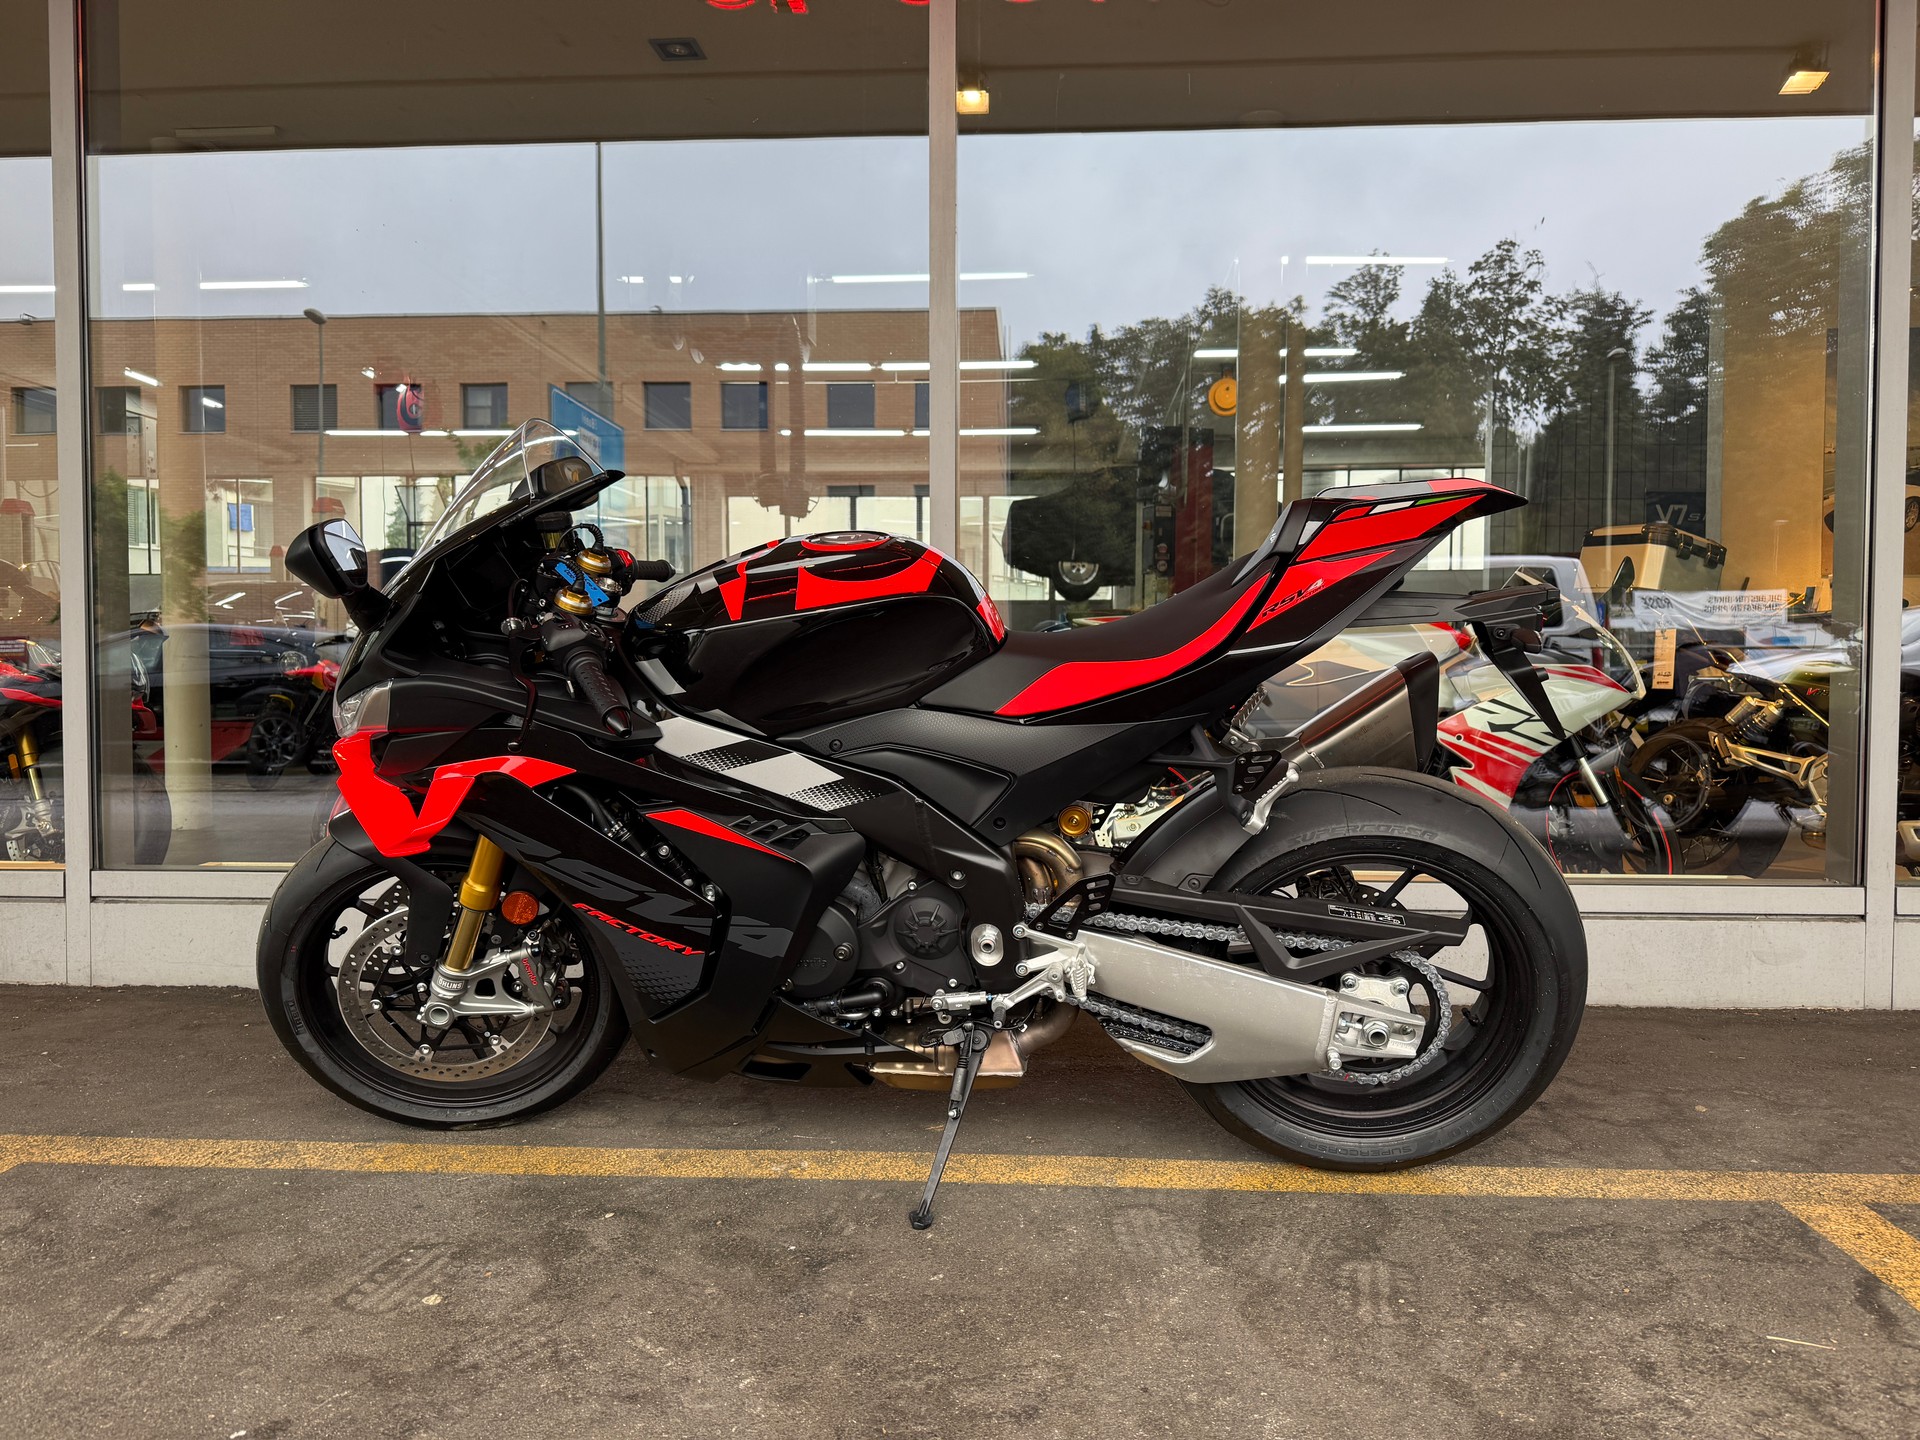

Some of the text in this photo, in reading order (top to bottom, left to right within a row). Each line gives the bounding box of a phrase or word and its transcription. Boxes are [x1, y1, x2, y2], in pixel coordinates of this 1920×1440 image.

[1655, 504, 1687, 526] V7
[1261, 578, 1325, 618] RSV4
[1287, 823, 1440, 847] SUPERCORSA
[571, 902, 706, 957] FACTORY
[521, 957, 538, 986] brembo
[1306, 1141, 1414, 1161] SUPERCORSA
